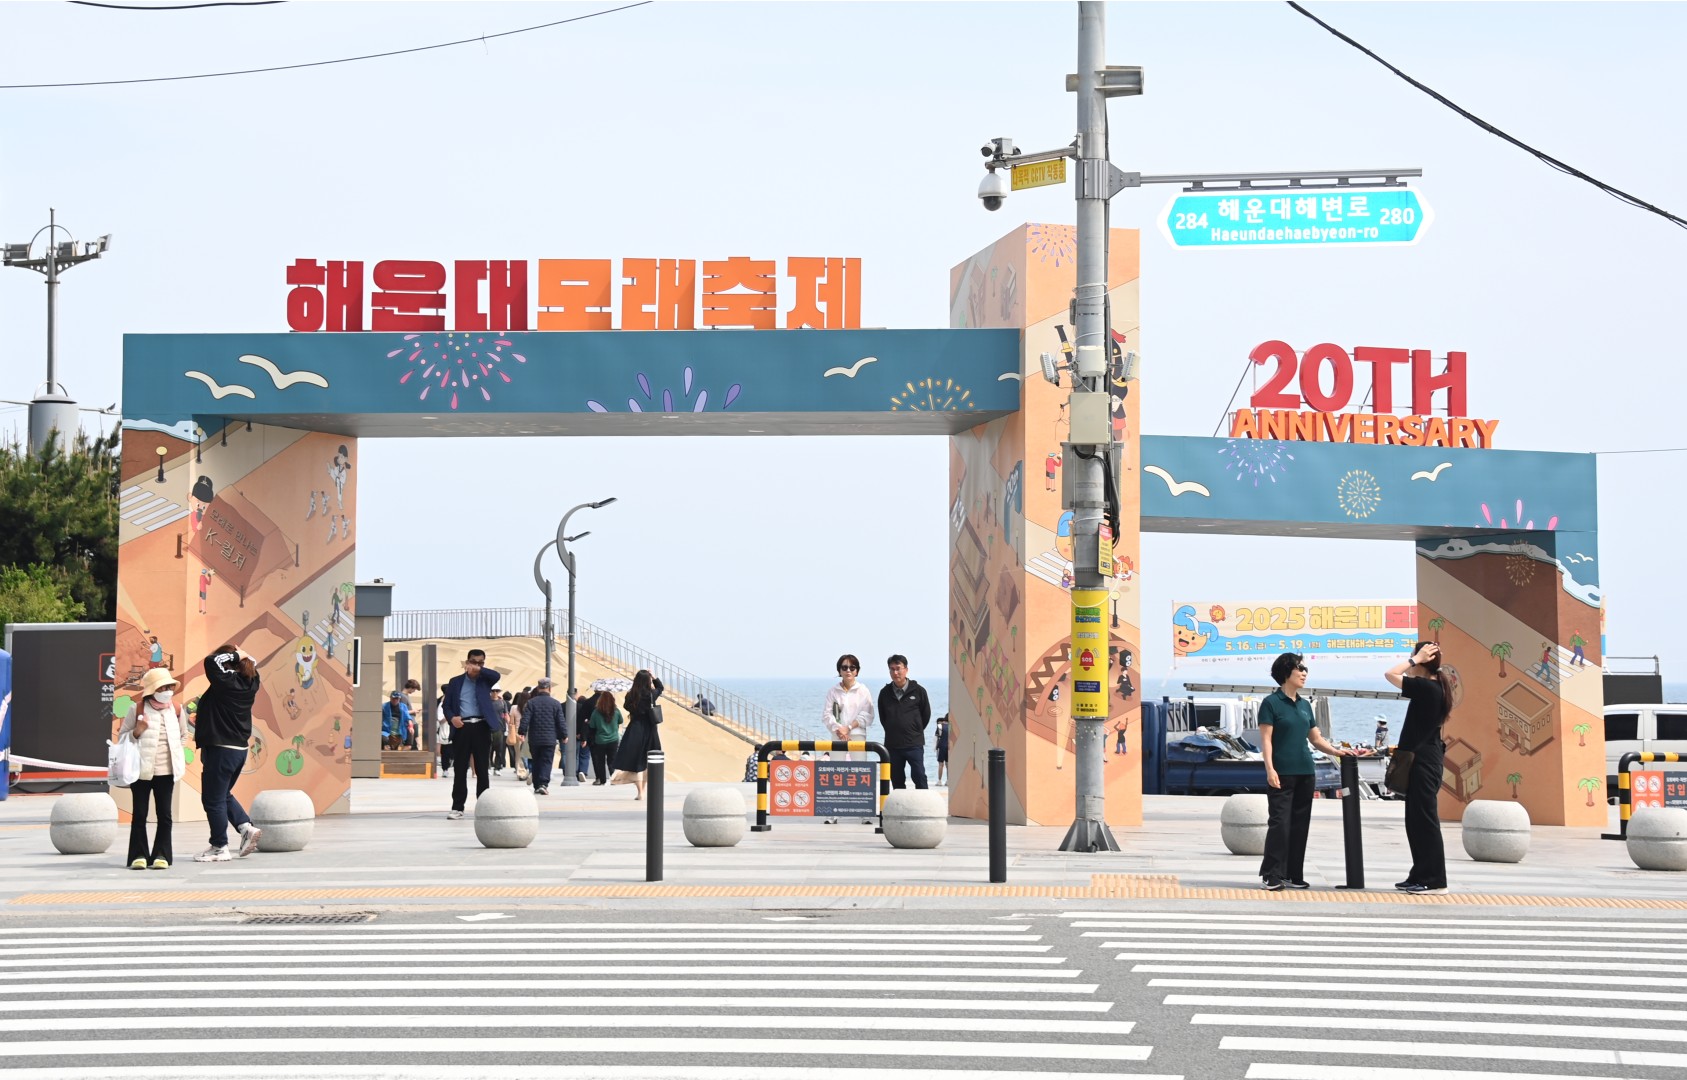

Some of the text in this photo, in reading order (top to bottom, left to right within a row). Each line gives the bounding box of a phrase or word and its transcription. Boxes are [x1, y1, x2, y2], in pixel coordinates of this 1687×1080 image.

[1030, 165, 1046, 183] CCTV
[1047, 162, 1064, 180] 작동중
[1175, 212, 1208, 230] 284
[1217, 196, 1370, 224] 해운대해변로
[1380, 207, 1415, 226] 280
[1210, 226, 1379, 243] Haeundaehaebyeon-ro
[1248, 339, 1468, 417] 20TH
[1230, 408, 1500, 449] ANNIVERSARY
[1235, 606, 1306, 631] 2025
[1308, 605, 1382, 629] 해운대
